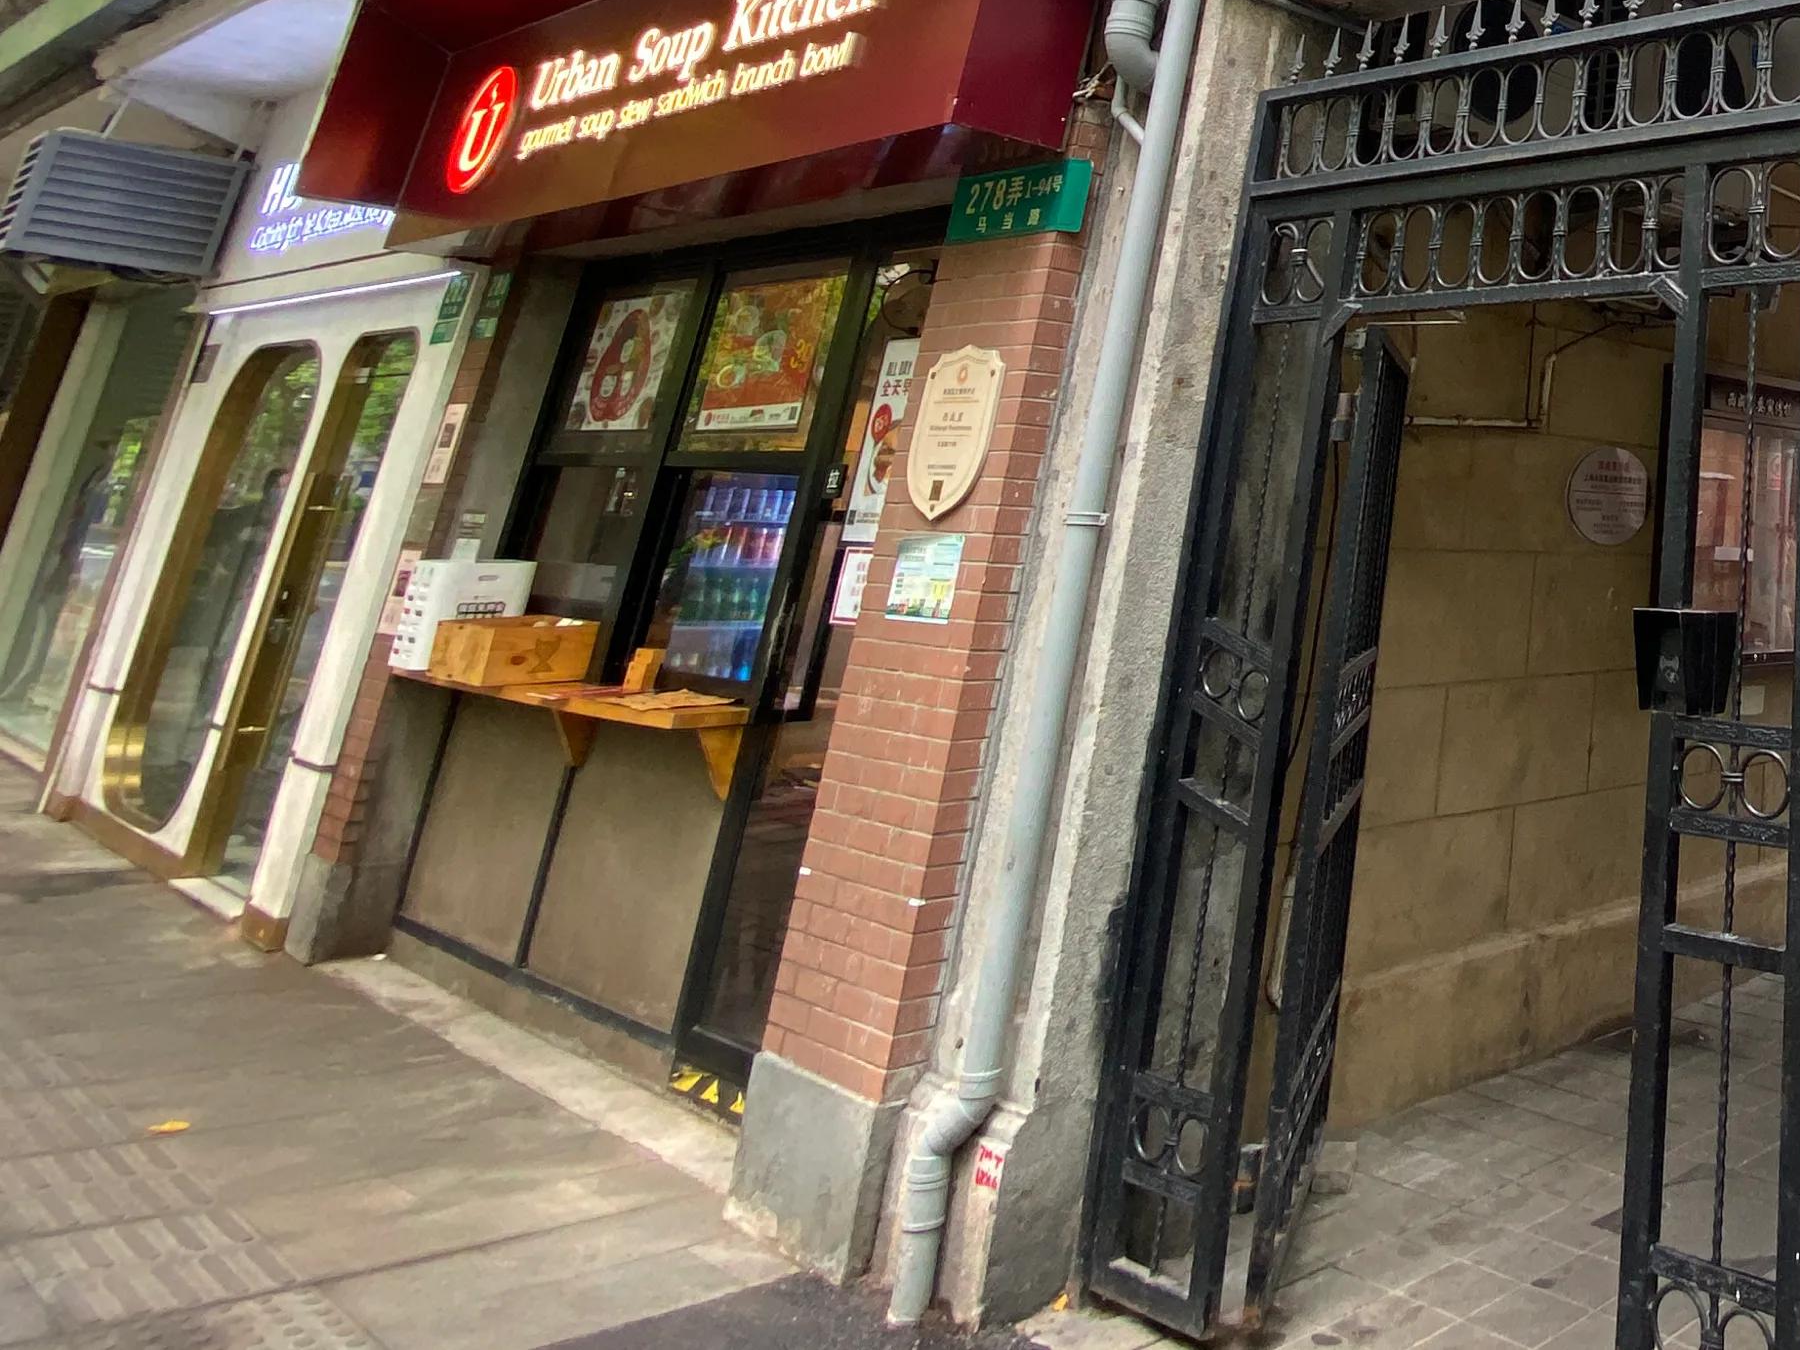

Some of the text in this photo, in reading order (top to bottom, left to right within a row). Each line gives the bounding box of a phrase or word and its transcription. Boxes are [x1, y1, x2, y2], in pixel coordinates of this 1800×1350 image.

[530, 50, 620, 111] Urban
[629, 21, 717, 83] Soup
[576, 110, 616, 142] soup
[652, 68, 729, 118] sandwich
[729, 49, 798, 97] brunch
[799, 31, 866, 78] bowl
[965, 176, 1025, 215] 278弄
[975, 208, 1041, 234] 马当路
